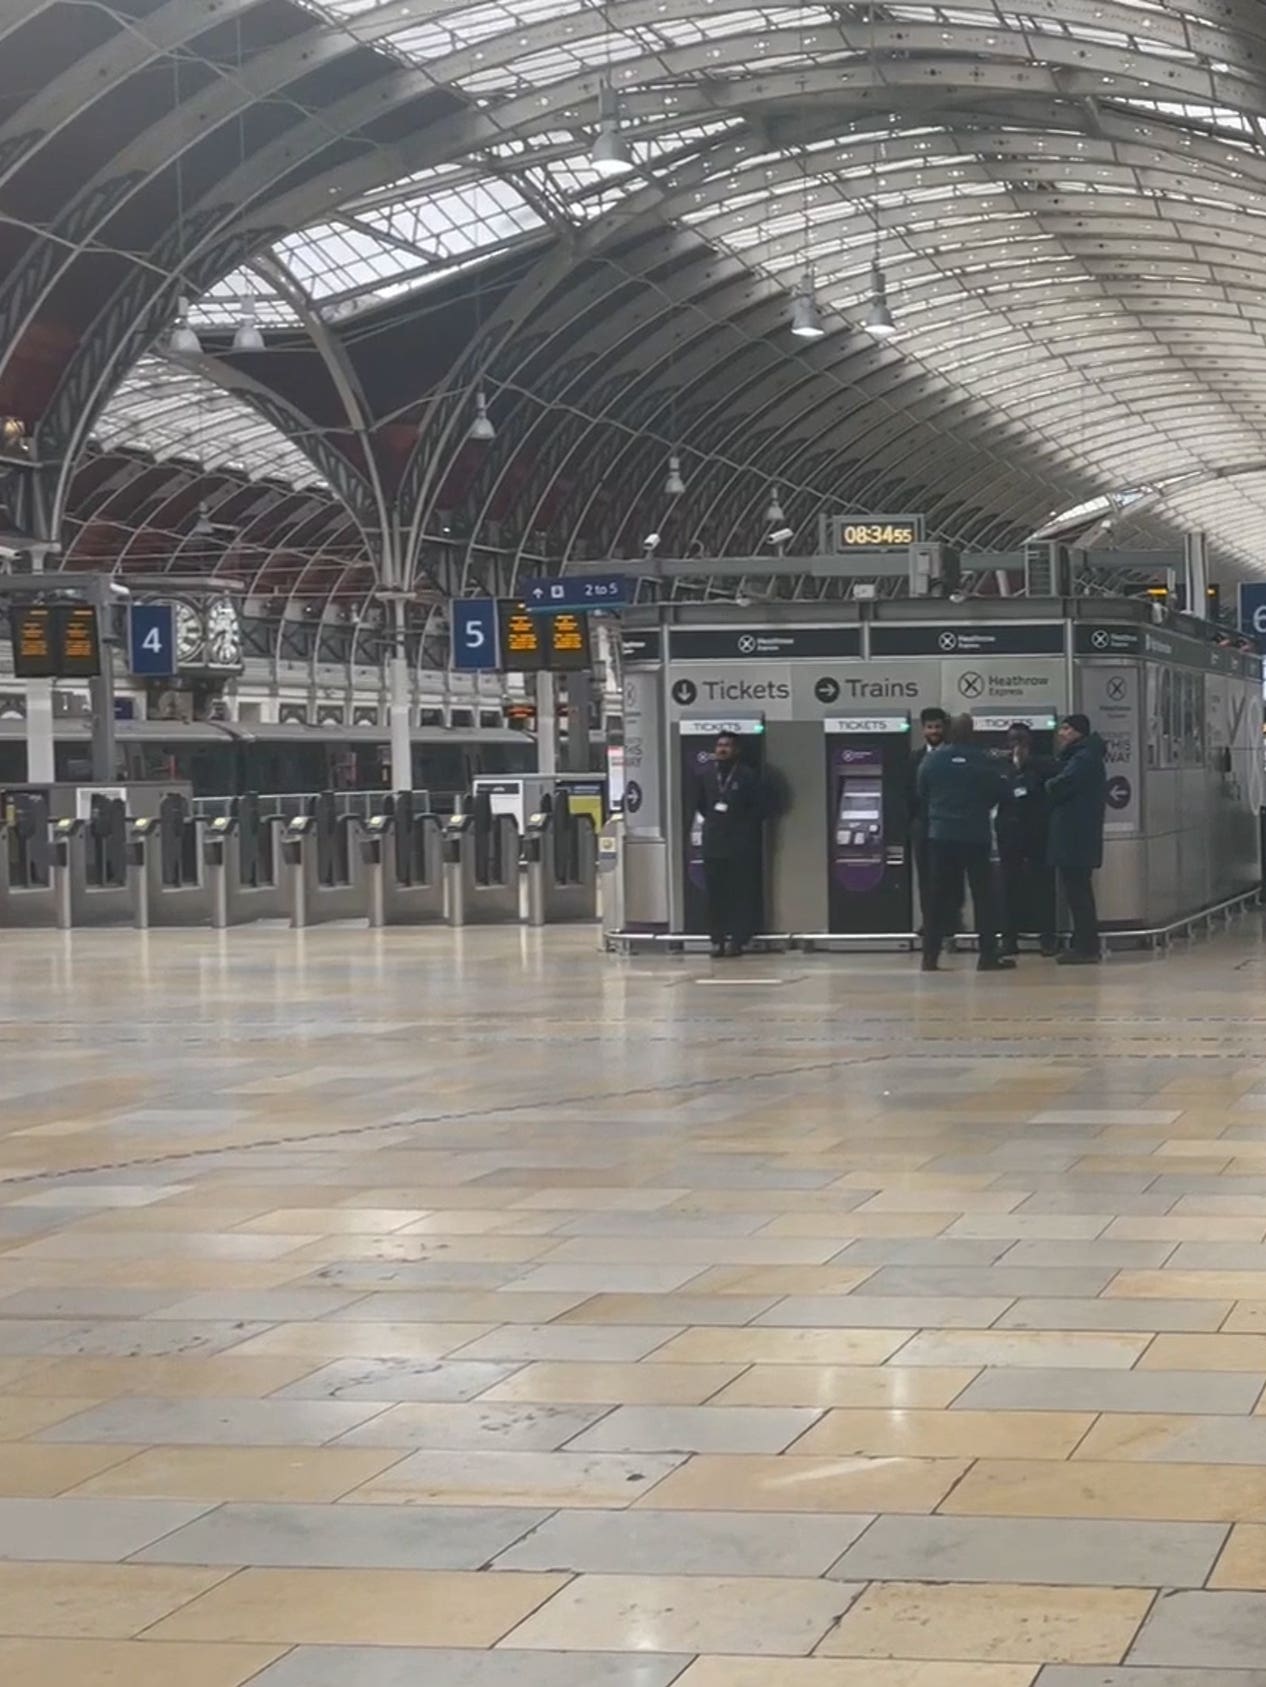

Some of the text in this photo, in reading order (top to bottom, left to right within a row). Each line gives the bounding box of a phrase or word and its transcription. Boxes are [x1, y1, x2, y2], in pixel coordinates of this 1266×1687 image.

[585, 582, 618, 596] 2 to 5
[142, 627, 162, 653] 4
[465, 620, 484, 648] 5
[702, 680, 790, 700] Tickets
[845, 678, 918, 698] Trains
[988, 676, 1049, 686] Heathrow
[838, 720, 888, 731] TICKETS
